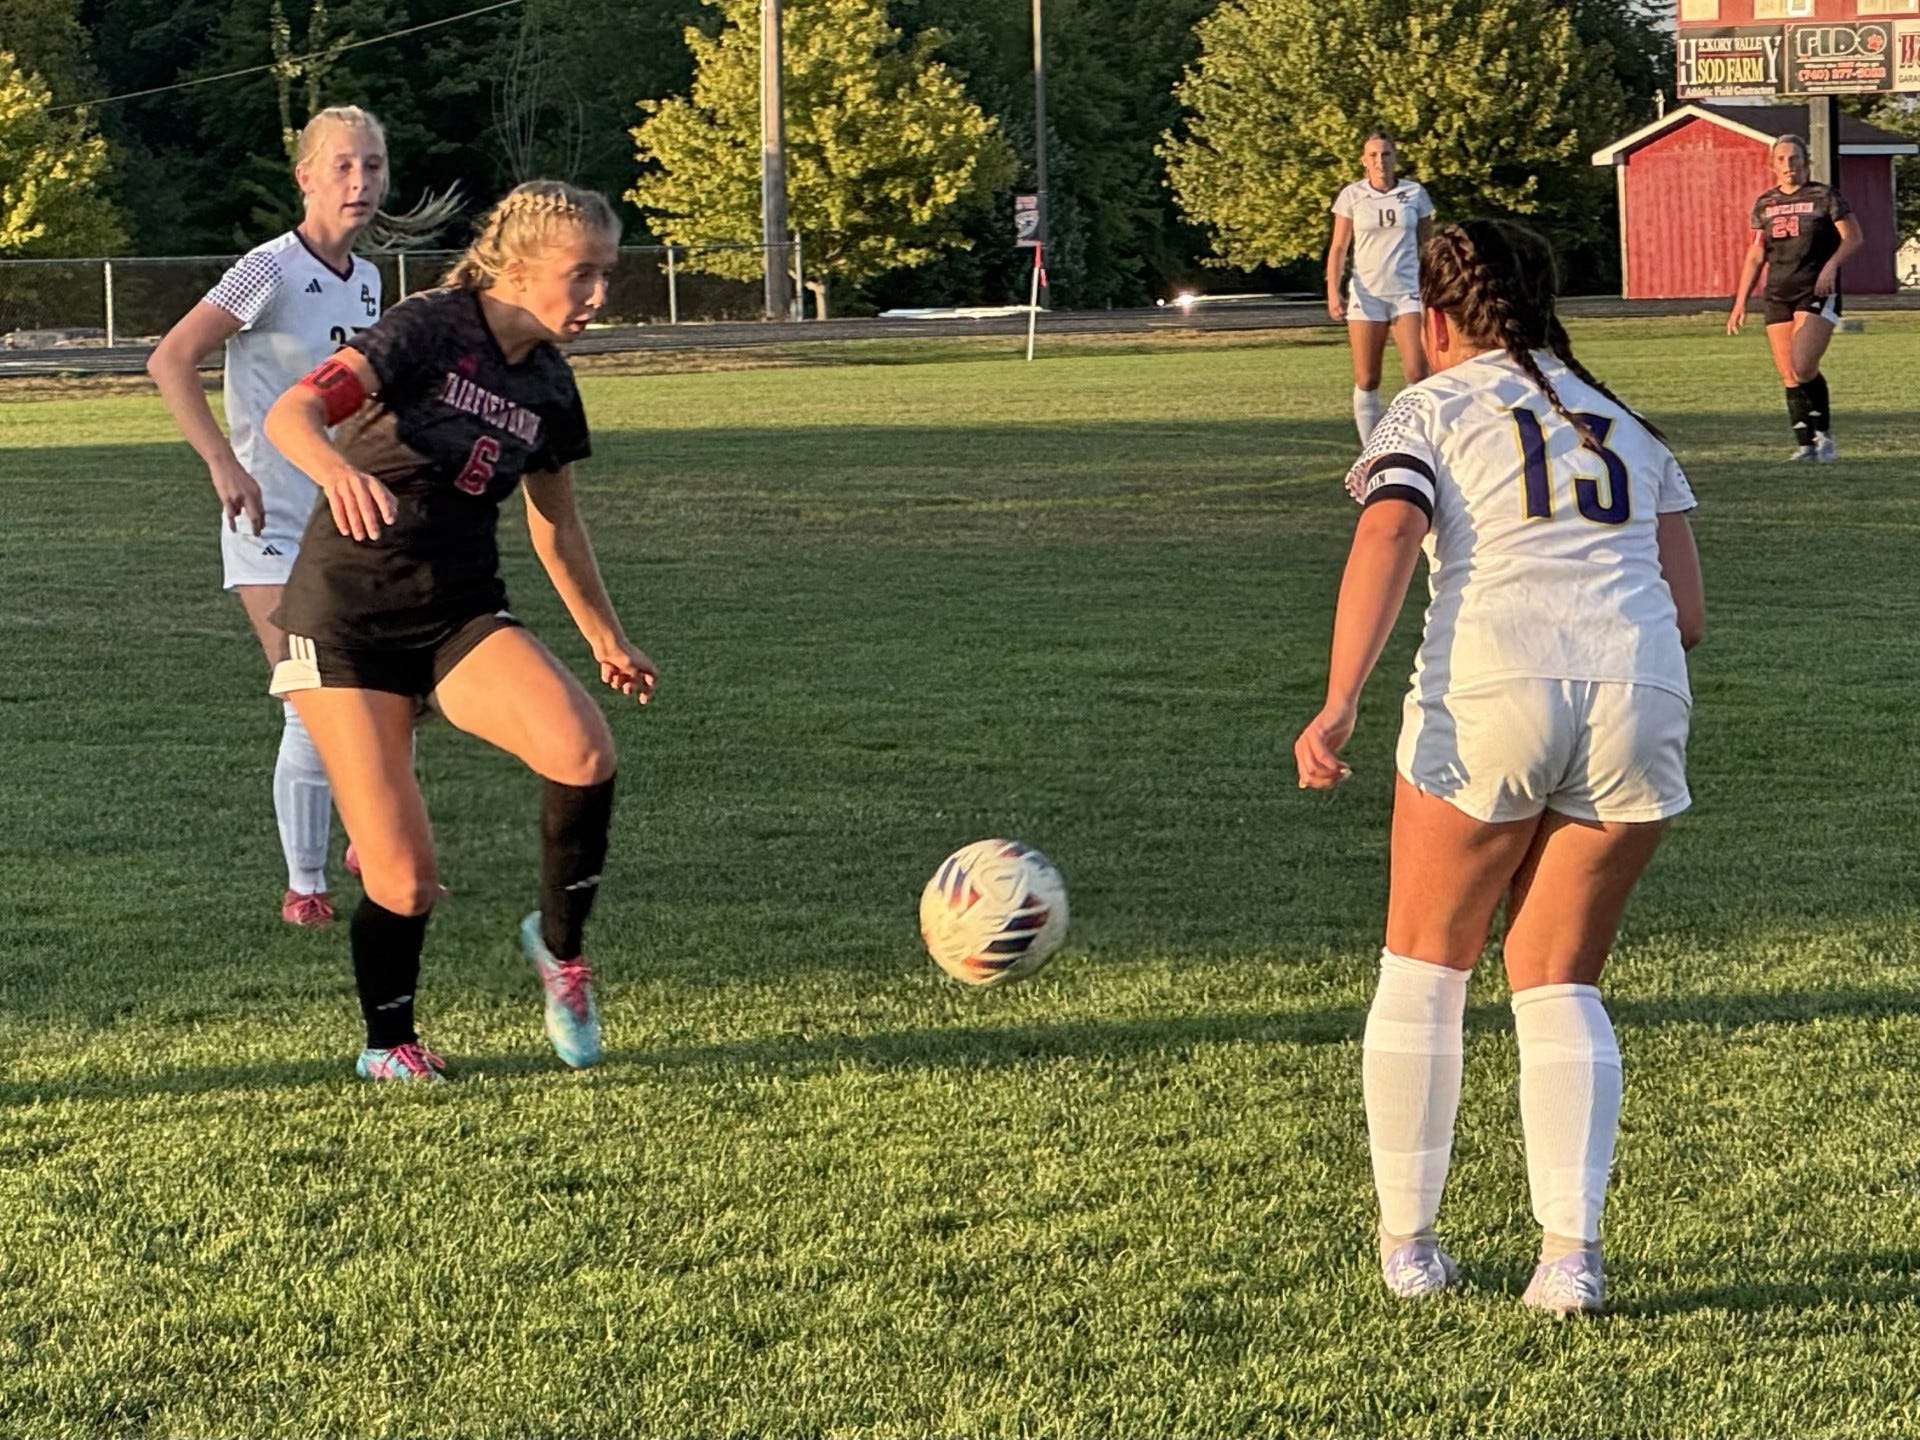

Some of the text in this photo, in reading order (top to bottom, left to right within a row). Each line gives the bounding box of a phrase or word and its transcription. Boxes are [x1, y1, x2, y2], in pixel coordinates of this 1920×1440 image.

[1796, 25, 1887, 56] FIDO
[1698, 57, 1764, 83] SOD FARM
[1714, 85, 1733, 96] Field
[1379, 208, 1396, 228] 19
[1772, 216, 1799, 238] 24
[361, 284, 376, 317] BC
[454, 435, 501, 495] 6
[1504, 405, 1633, 526] 13
